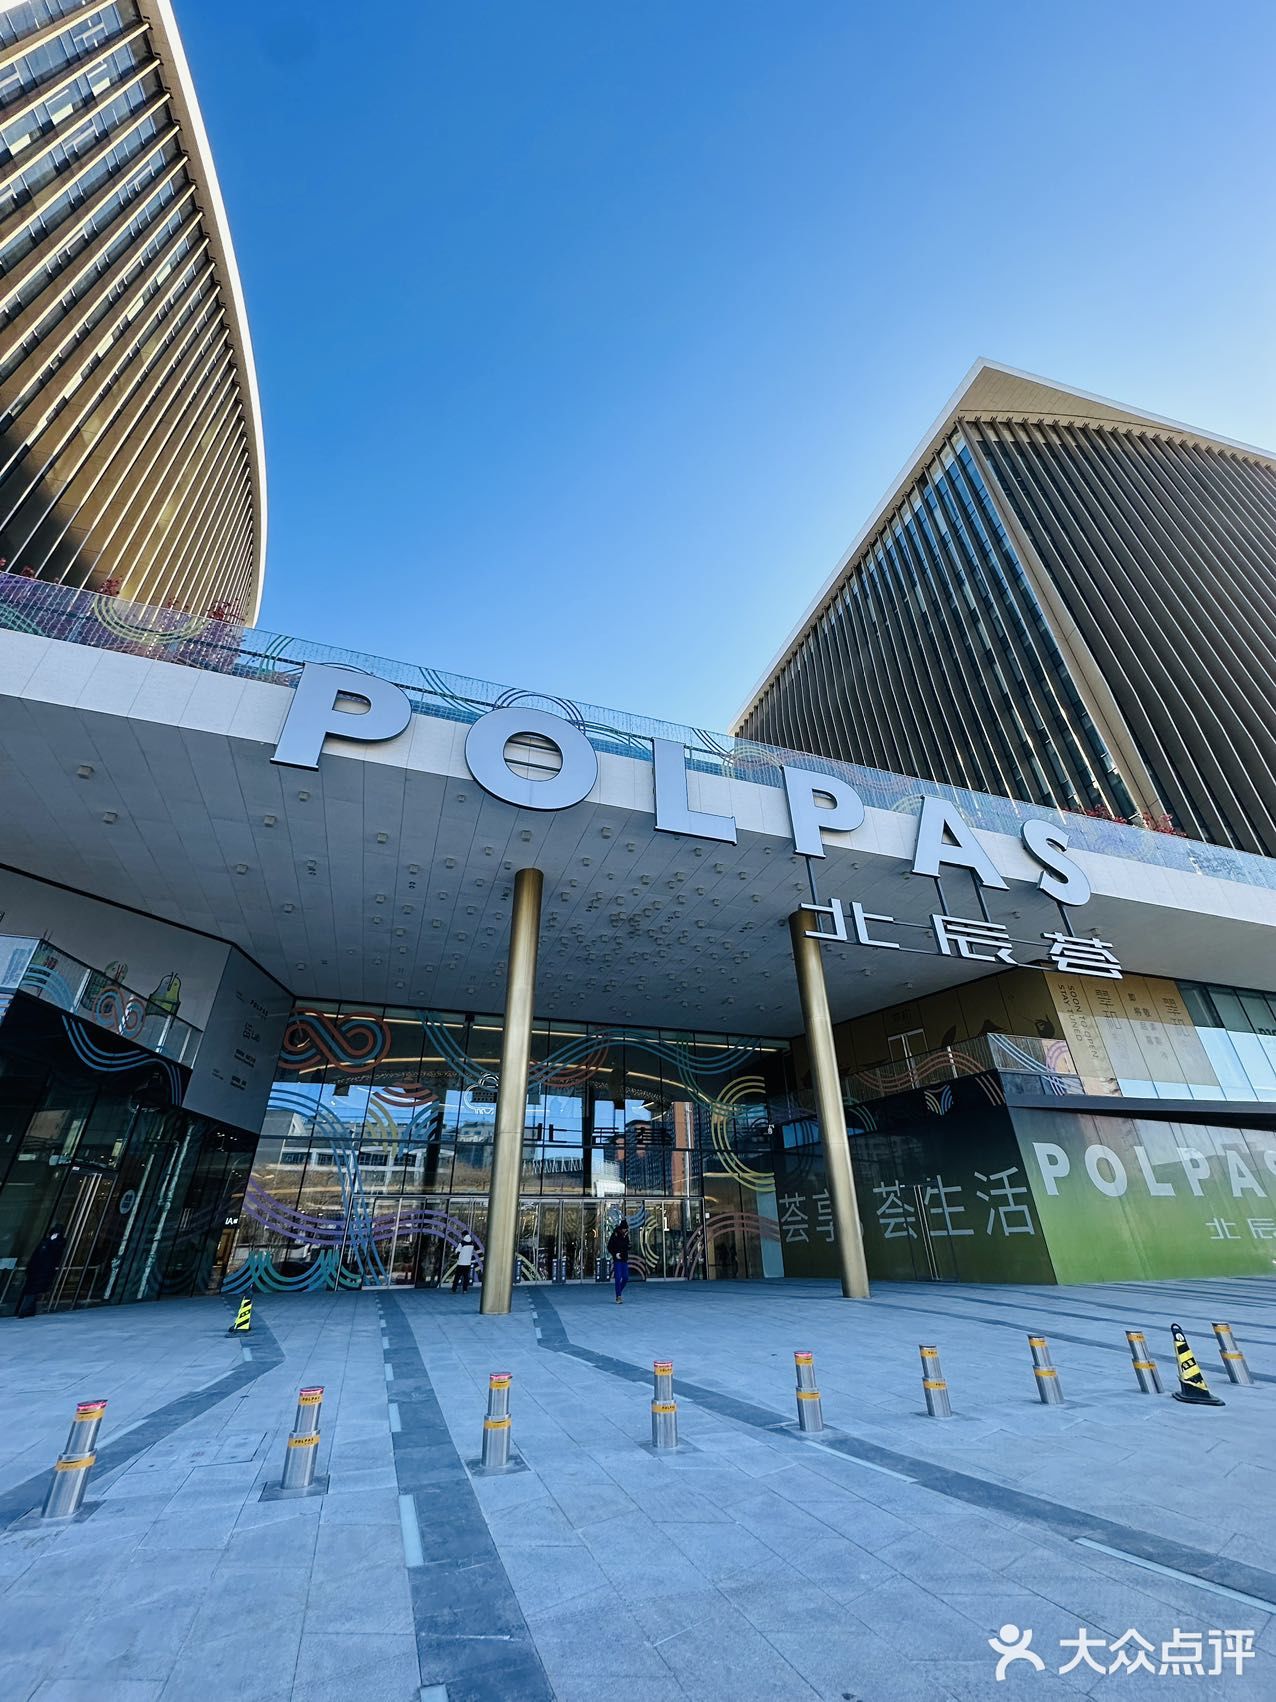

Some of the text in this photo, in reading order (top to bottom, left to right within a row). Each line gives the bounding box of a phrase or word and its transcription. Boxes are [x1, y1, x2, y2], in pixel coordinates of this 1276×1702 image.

[270, 662, 1091, 906] POLPAS
[799, 897, 1123, 979] 北辰荟
[1058, 983, 1083, 1042] STAY TUNED
[1067, 985, 1082, 1013] SOON
[1084, 1030, 1099, 1059] OPEN
